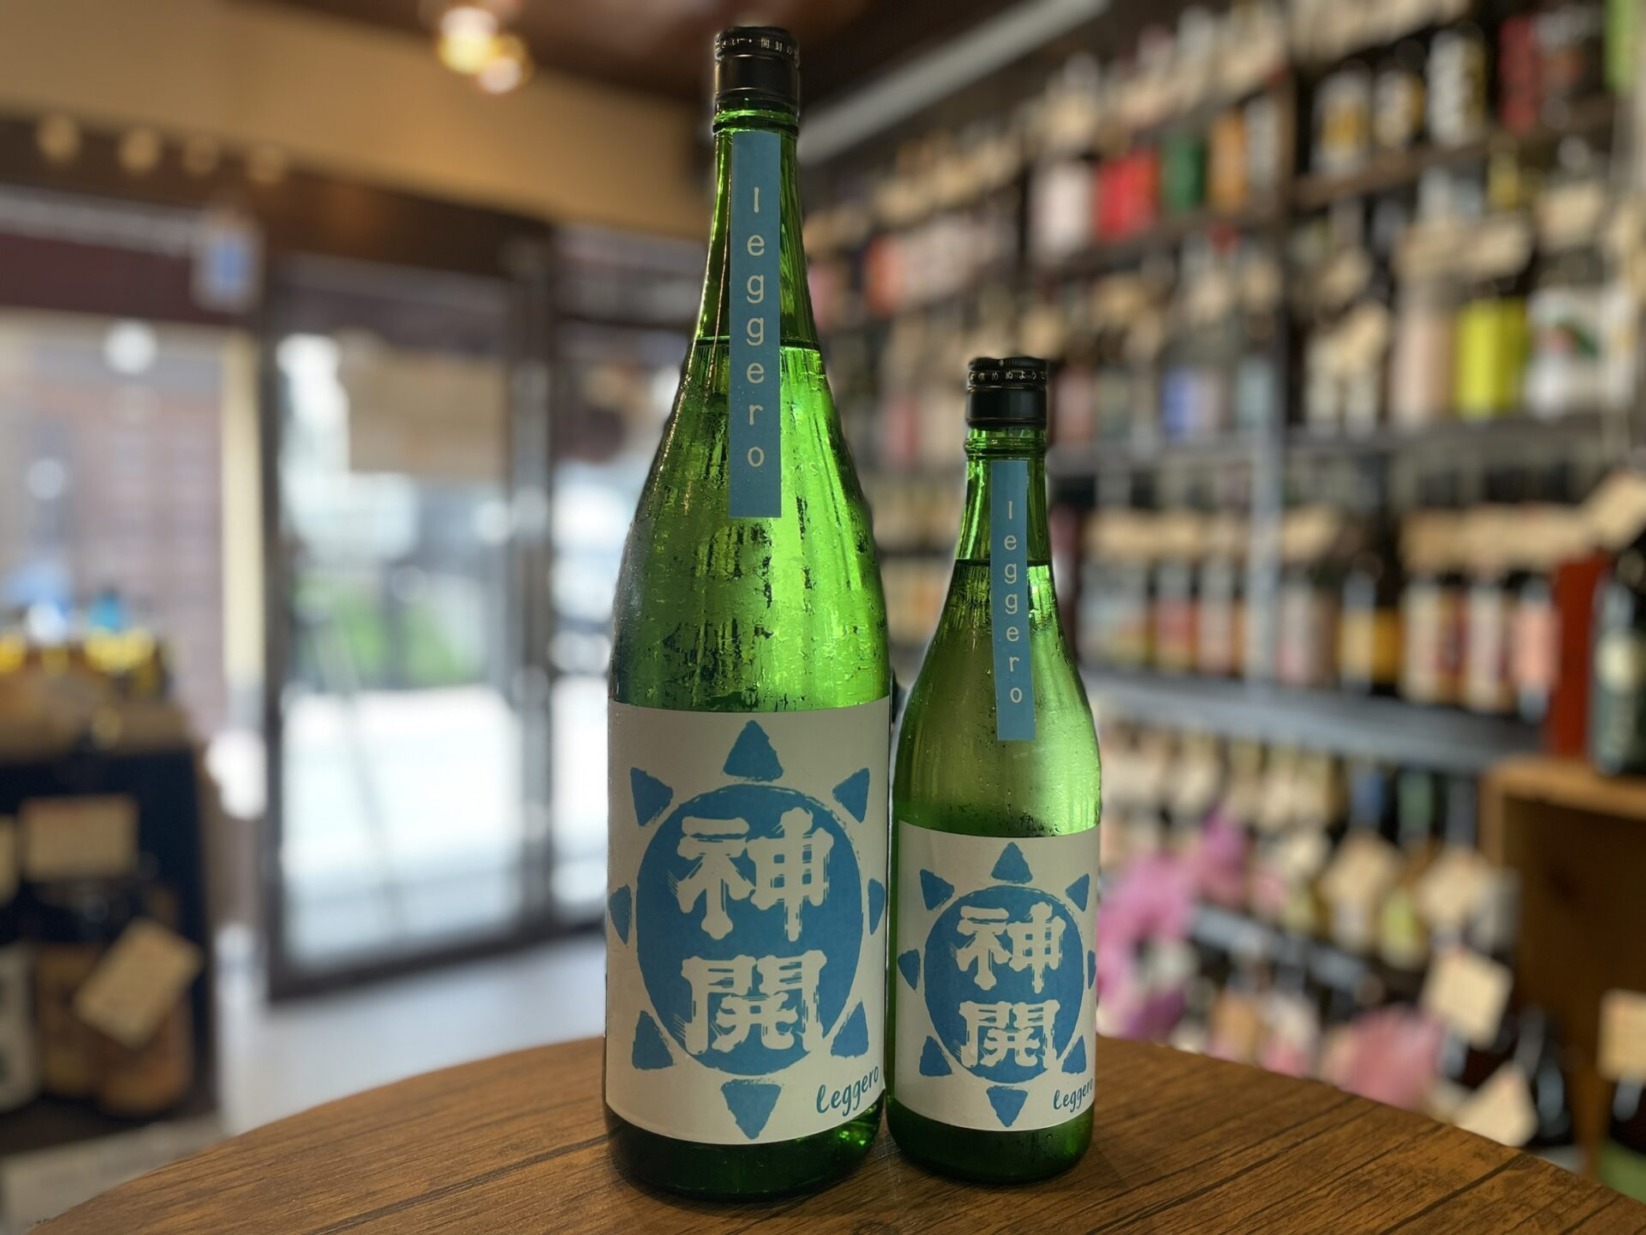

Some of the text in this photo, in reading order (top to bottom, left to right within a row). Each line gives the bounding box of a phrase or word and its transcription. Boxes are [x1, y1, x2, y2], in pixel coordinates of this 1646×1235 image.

[745, 186, 766, 469] leggero
[1003, 500, 1023, 704] leggero
[816, 1065, 880, 1117] leggero
